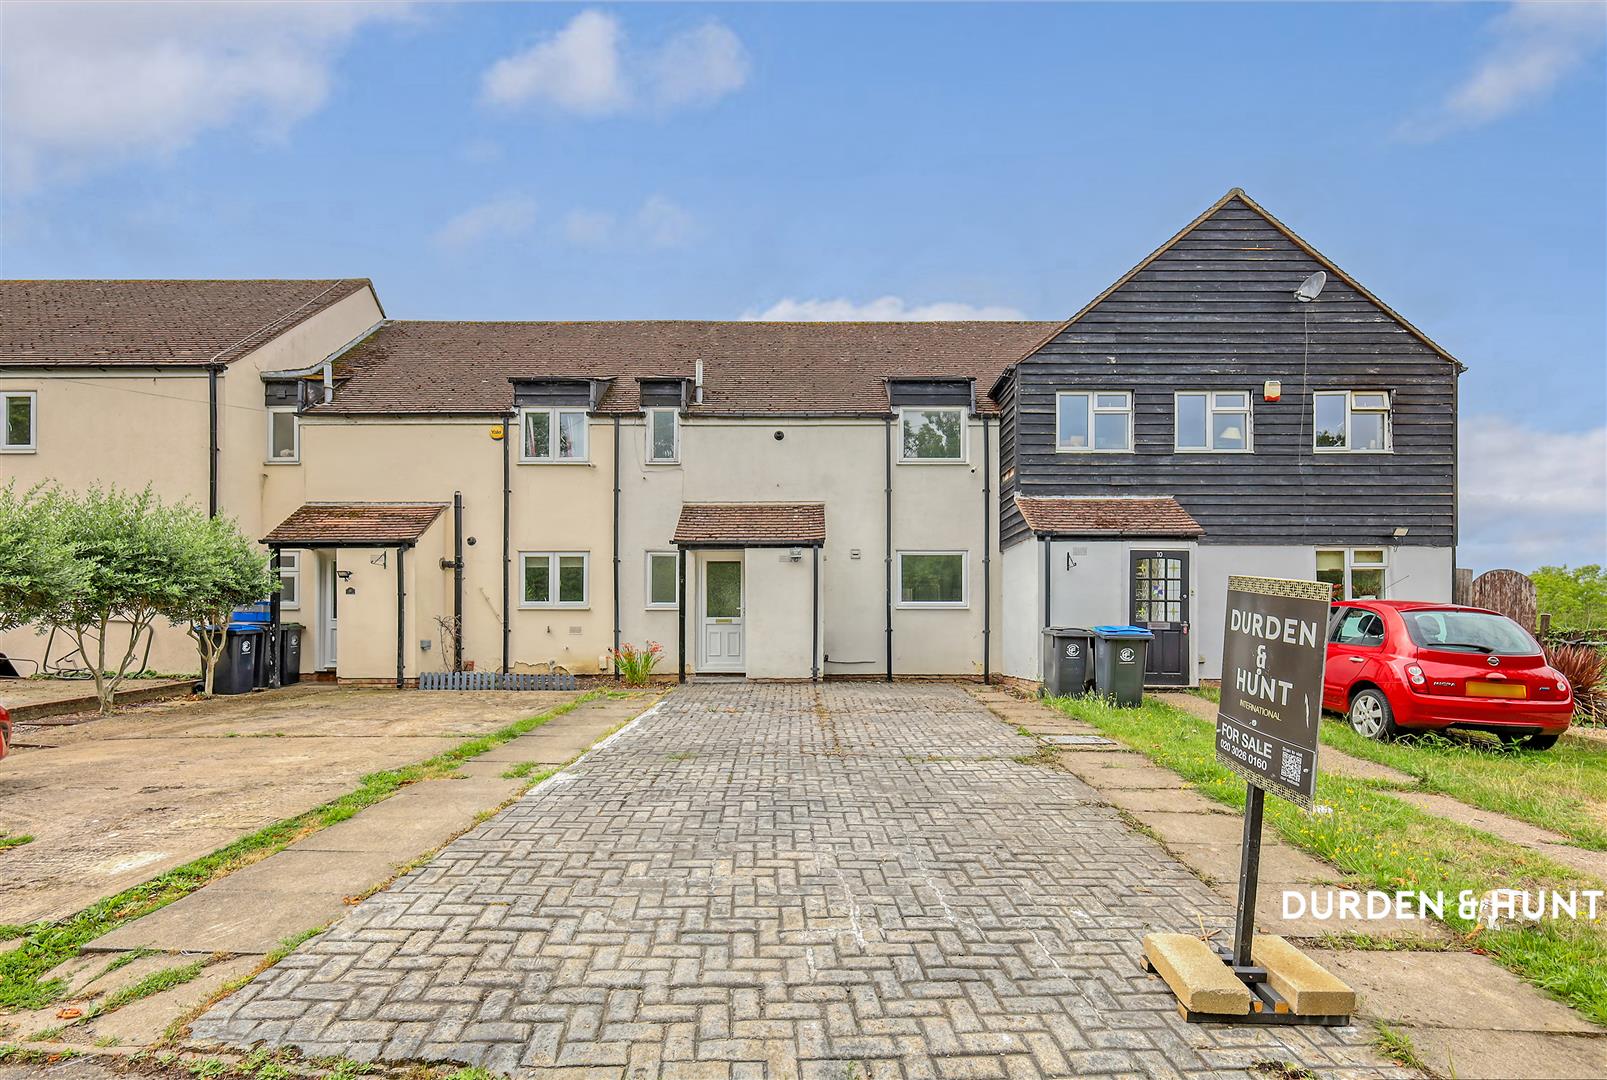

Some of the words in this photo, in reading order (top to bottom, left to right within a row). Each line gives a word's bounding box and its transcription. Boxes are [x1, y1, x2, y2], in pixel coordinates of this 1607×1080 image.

[1230, 609, 1317, 648] DURDEN
[1256, 644, 1267, 669] &
[1236, 667, 1293, 706] HUNT
[1239, 699, 1282, 721] INTERNATIONAL
[1220, 738, 1231, 752] 020
[1231, 745, 1247, 761] 3026
[1248, 754, 1267, 771] 0160
[1221, 722, 1240, 744] FOR
[1241, 733, 1273, 759] SALE
